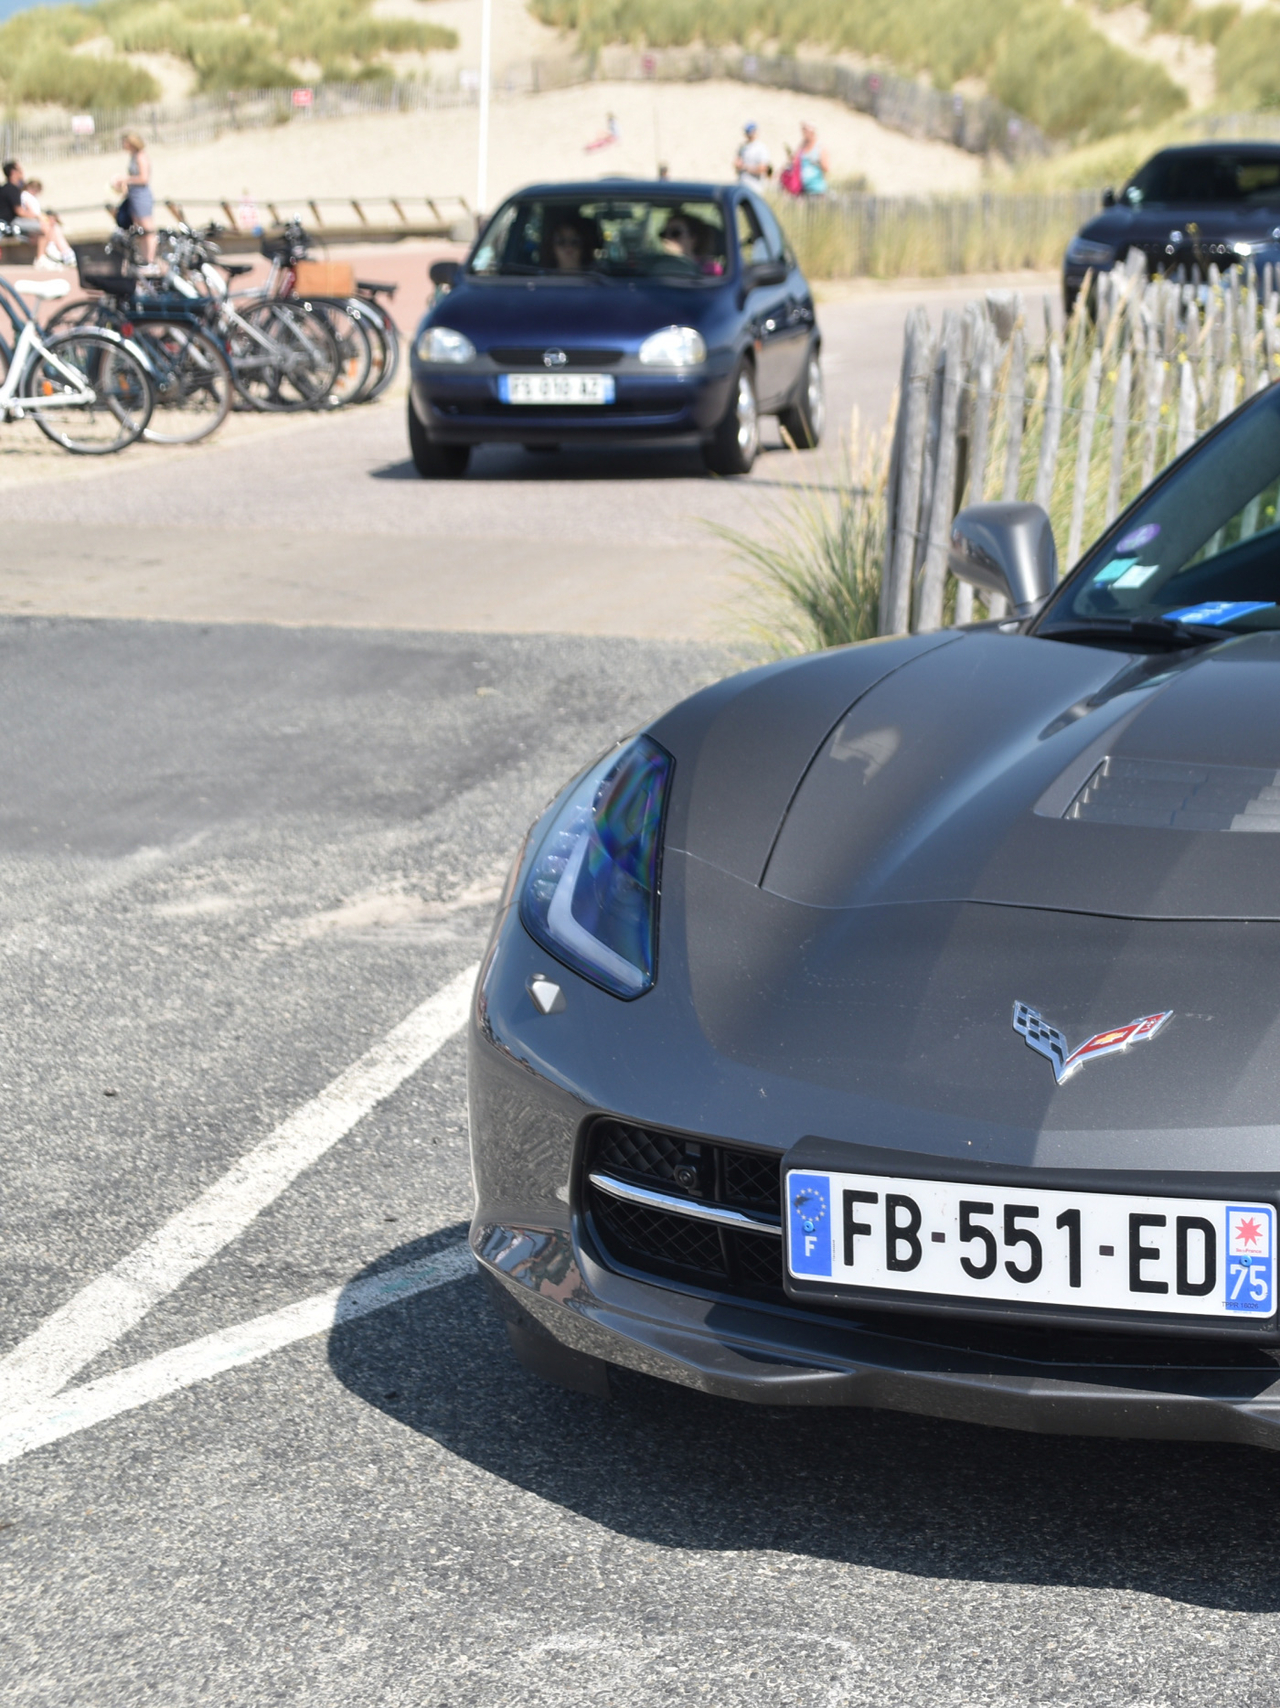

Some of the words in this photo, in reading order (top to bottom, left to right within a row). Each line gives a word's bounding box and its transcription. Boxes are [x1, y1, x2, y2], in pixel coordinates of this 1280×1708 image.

[805, 1235, 818, 1257] F
[842, 1188, 1217, 1297] FB-551-ED
[1230, 1264, 1268, 1301] 75
